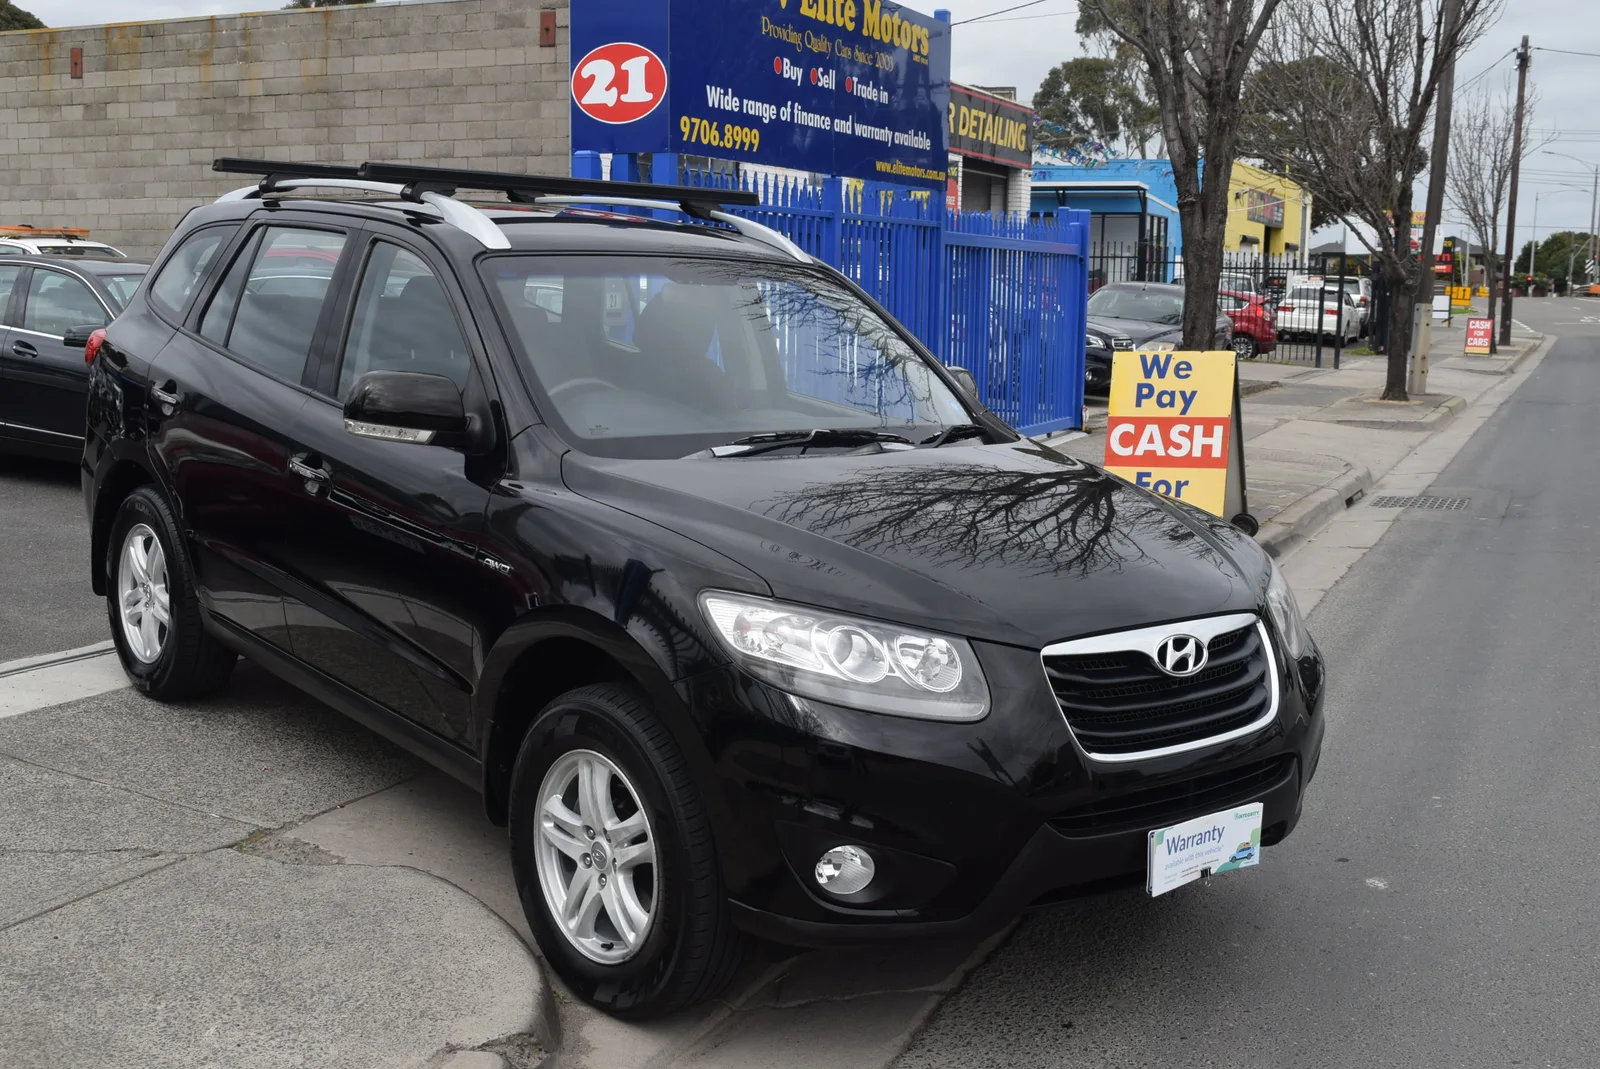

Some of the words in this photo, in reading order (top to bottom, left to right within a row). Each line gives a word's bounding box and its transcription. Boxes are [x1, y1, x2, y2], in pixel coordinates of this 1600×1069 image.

[761, 15, 803, 53] Providing
[804, 30, 833, 60] Quality
[834, 38, 852, 60] Cars
[853, 44, 873, 66] Since
[862, 0, 929, 56] Motors
[580, 55, 654, 108] 21
[782, 57, 803, 87] Buy
[817, 67, 836, 91] Sell
[852, 76, 878, 101] Trade
[879, 85, 889, 105] in
[680, 115, 760, 153] 9706.8999
[706, 84, 740, 113] Wide
[742, 98, 777, 124] range
[779, 100, 792, 123] of
[793, 102, 831, 131] finance
[833, 115, 852, 135] and
[854, 121, 893, 148] warranty
[894, 128, 931, 151] available
[958, 105, 1028, 152] DETAILING
[1467, 337, 1489, 347] CARS
[1469, 320, 1491, 330] CASH
[1139, 353, 1193, 380] We
[1135, 382, 1198, 416] Pay
[1109, 422, 1224, 458] CASH
[1166, 825, 1225, 856] Warranty
